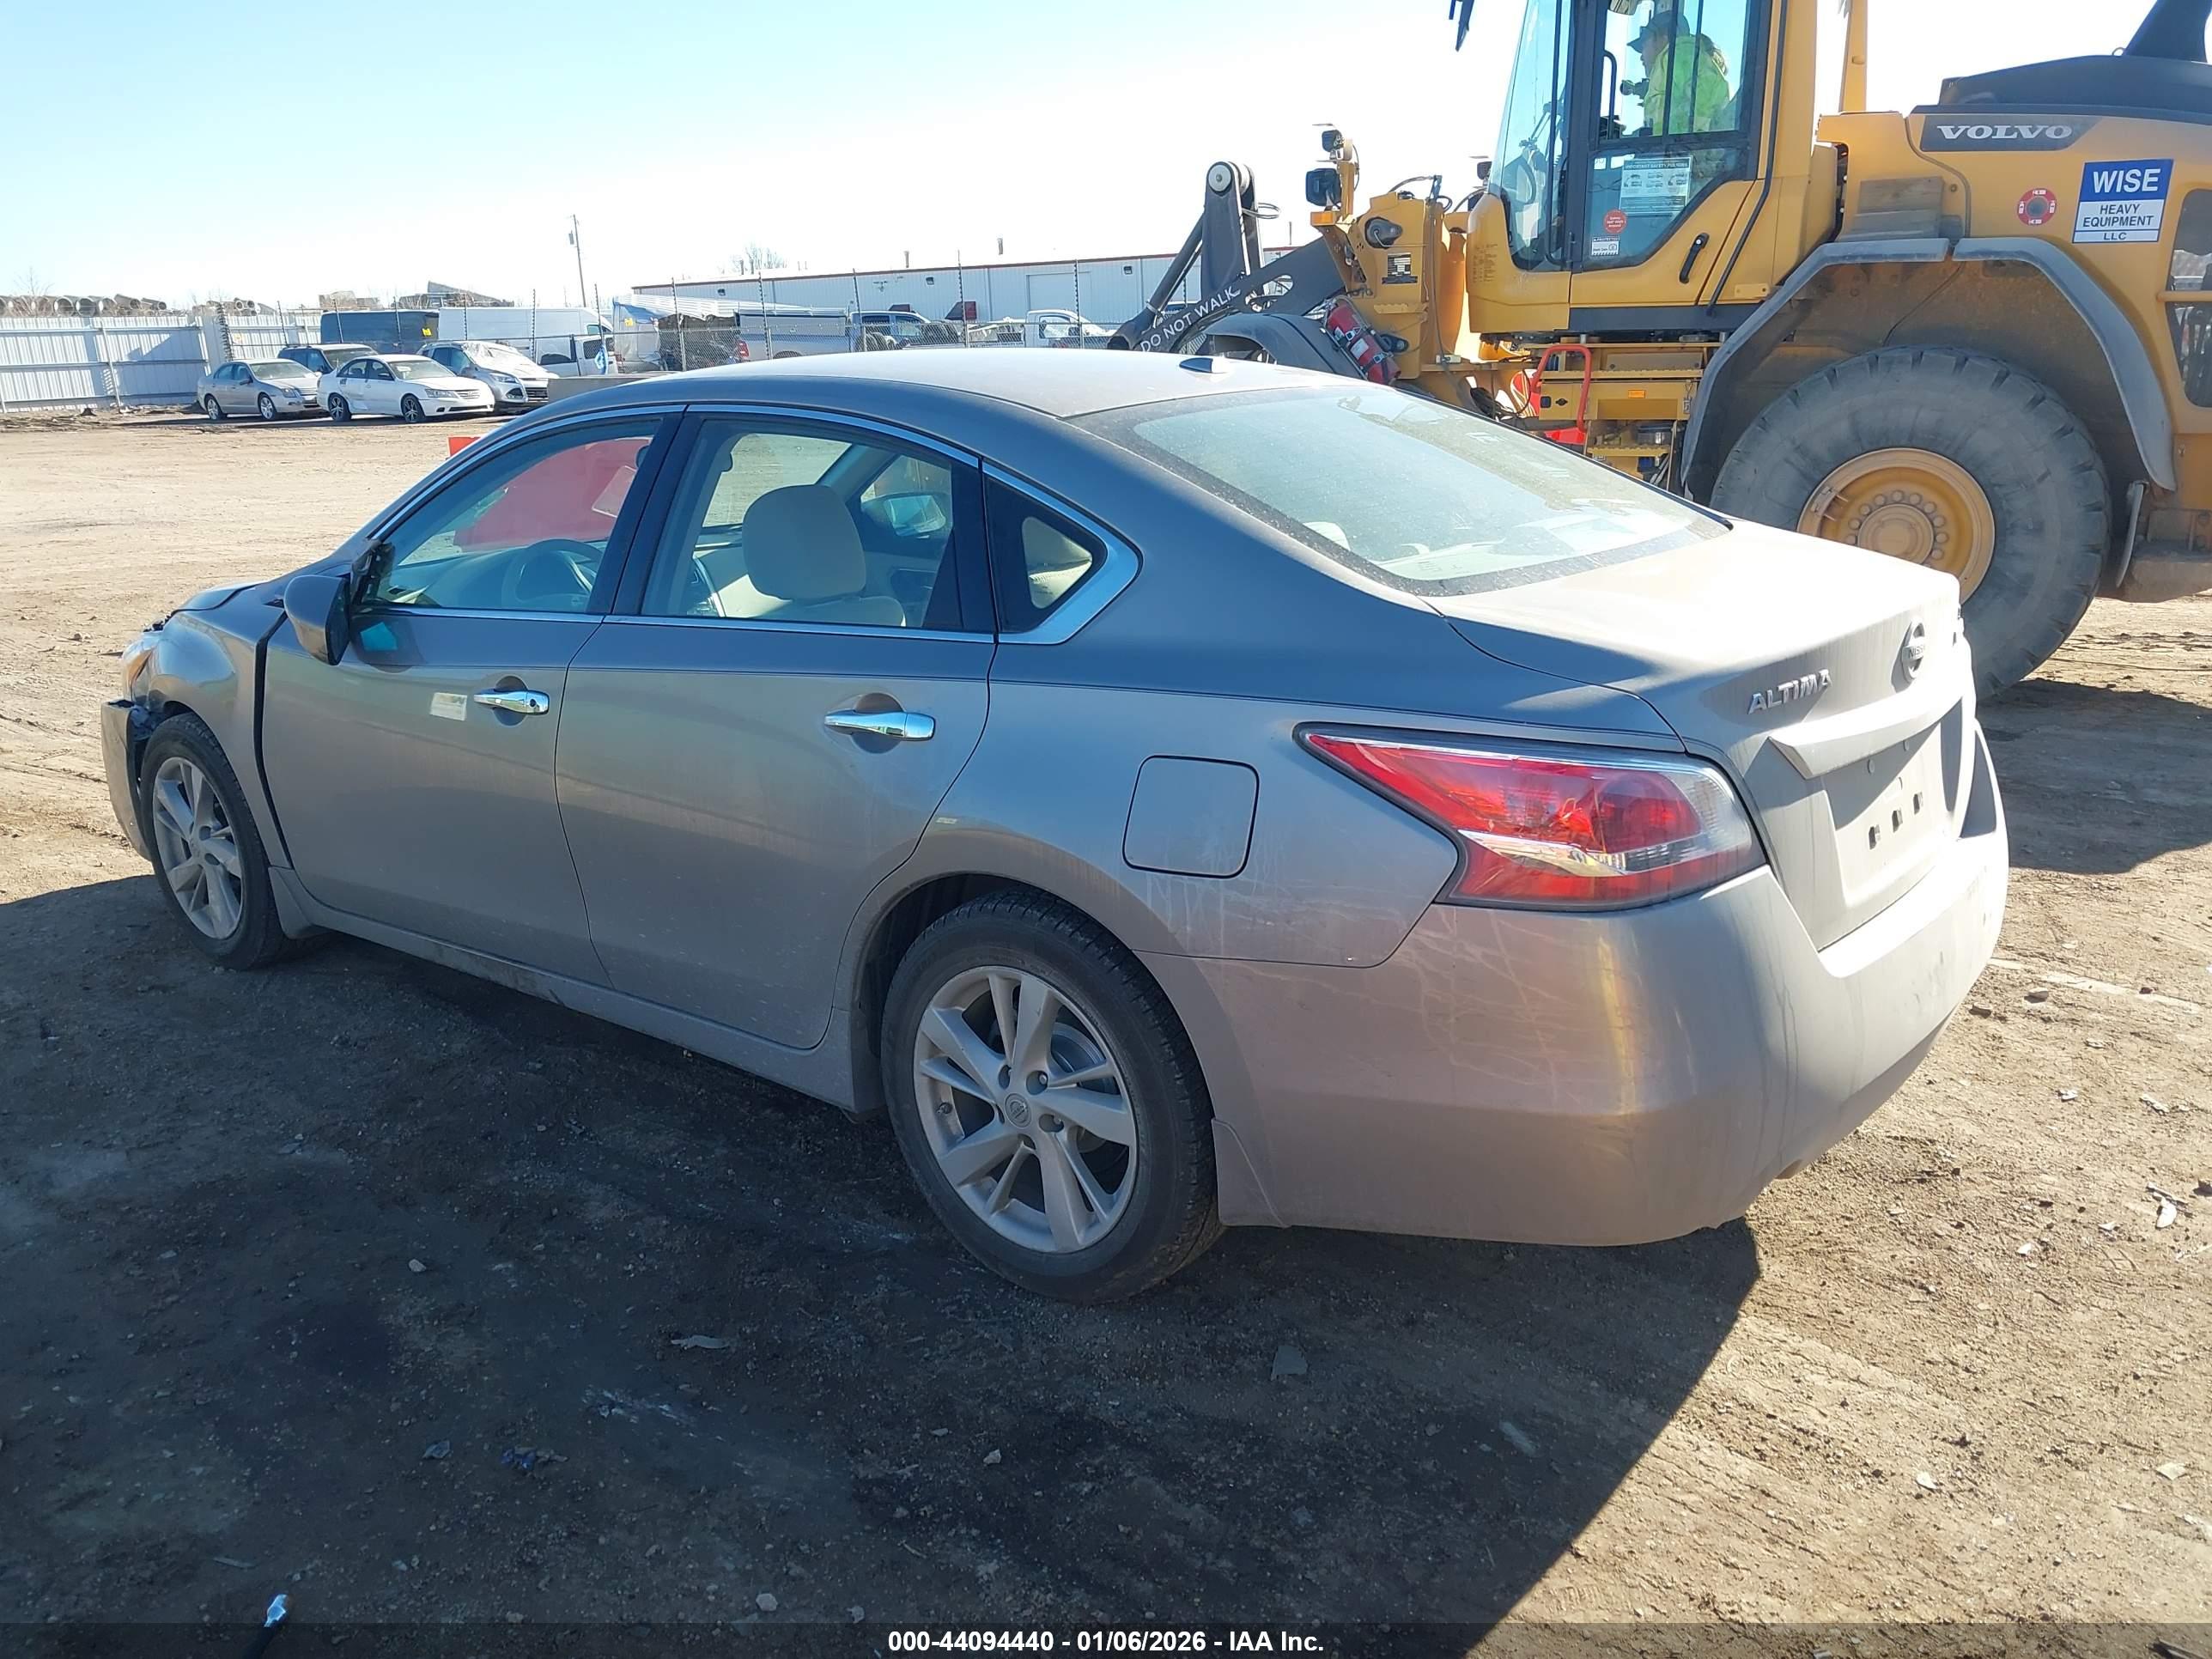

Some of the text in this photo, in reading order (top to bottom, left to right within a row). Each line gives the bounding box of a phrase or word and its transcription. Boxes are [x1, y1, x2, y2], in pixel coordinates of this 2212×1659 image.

[1936, 125, 2073, 139] VOLVO
[2093, 167, 2161, 193] WISE
[2100, 204, 2141, 215] HEAVY
[2082, 215, 2154, 228] EQUIPMENT
[2103, 232, 2127, 240] LLC
[1140, 285, 1241, 352] DO NOT WALK
[1747, 668, 1832, 715] ALTIMA
